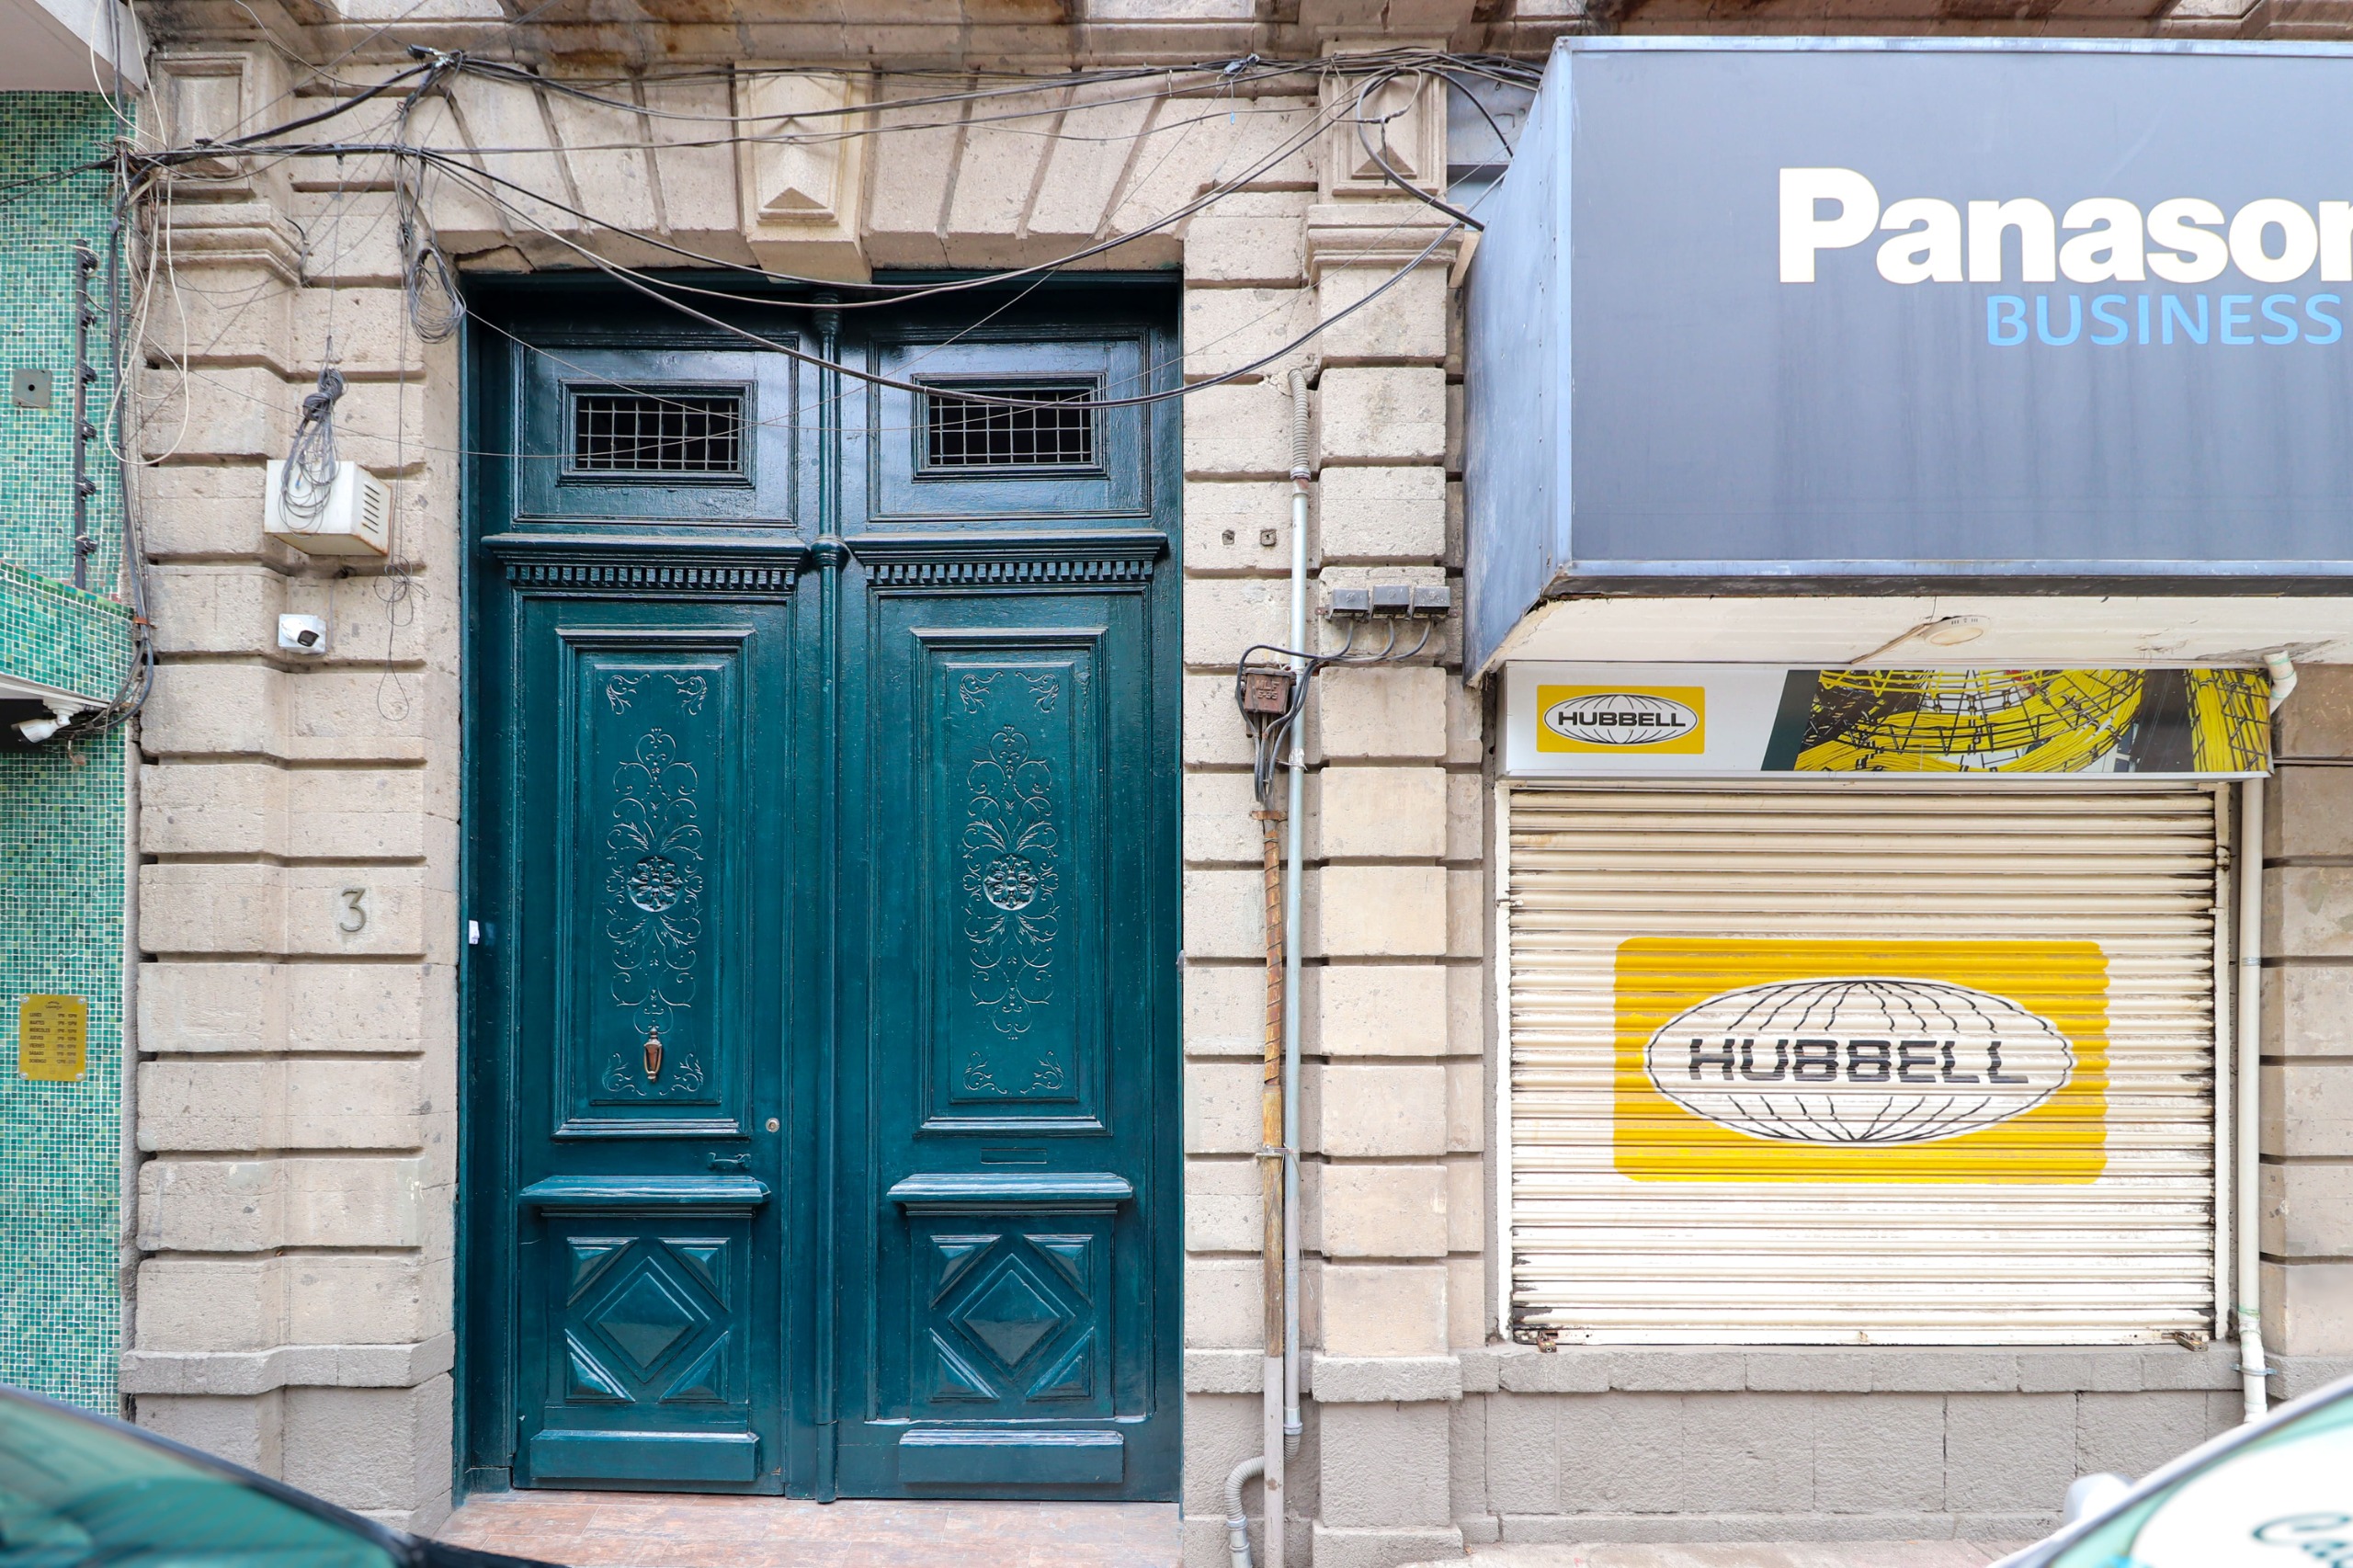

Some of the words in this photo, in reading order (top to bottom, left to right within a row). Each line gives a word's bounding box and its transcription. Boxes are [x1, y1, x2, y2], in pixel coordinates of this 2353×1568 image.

[1986, 293, 2343, 346] BUSINESS
[1558, 711, 1687, 727] HUBBELL
[339, 888, 367, 932] 3
[1688, 1038, 2029, 1085] HUBBELL
